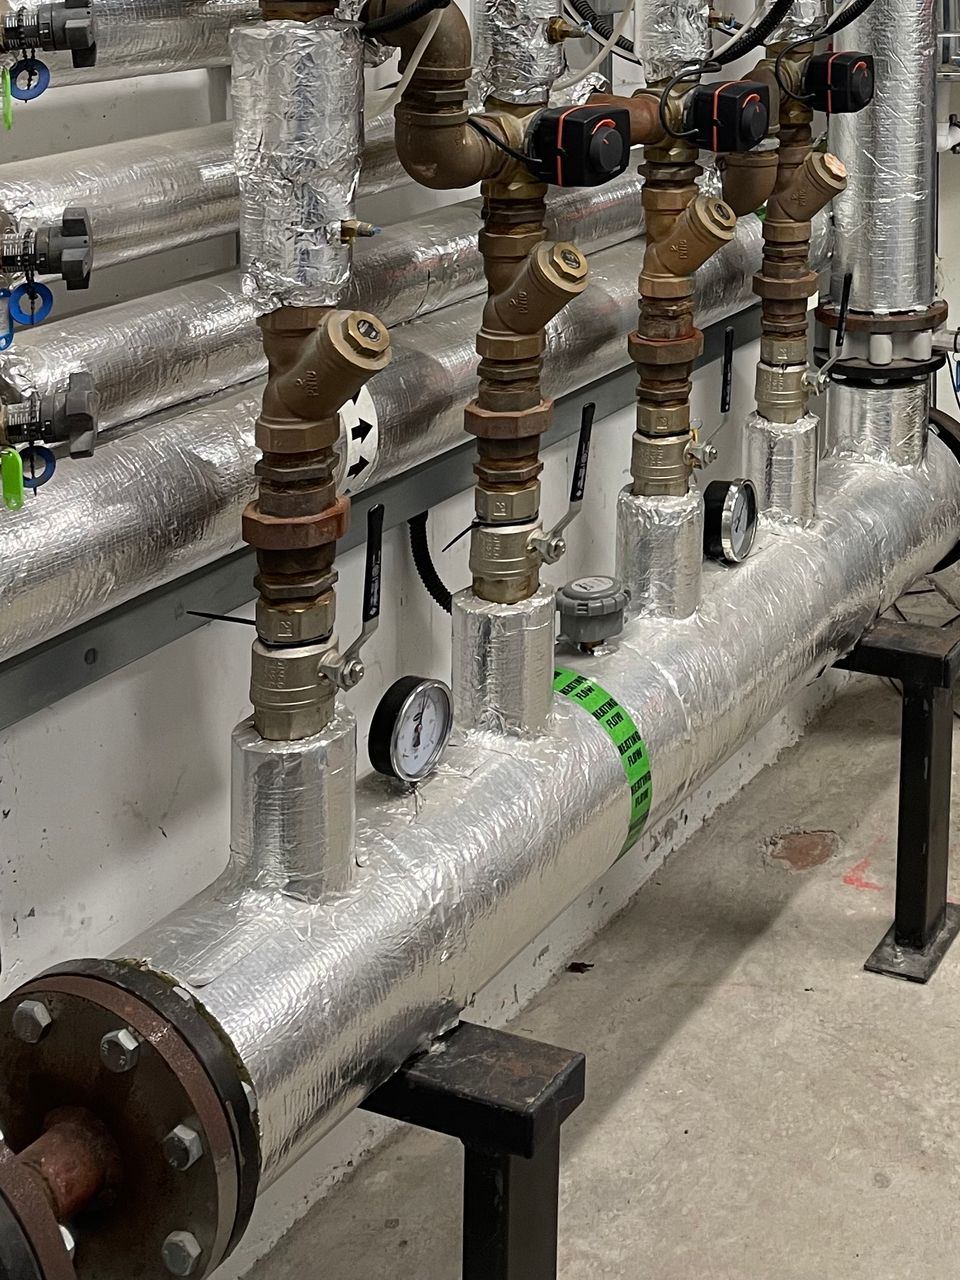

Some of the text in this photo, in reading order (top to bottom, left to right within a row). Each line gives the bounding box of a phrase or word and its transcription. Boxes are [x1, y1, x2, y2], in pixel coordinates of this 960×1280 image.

[558, 674, 588, 696] HEATING
[575, 685, 595, 701] FLOW
[591, 697, 619, 721] HEATING
[605, 711, 625, 730] FLOW
[618, 730, 642, 756] HEATING
[627, 747, 643, 767] FLOW
[630, 770, 651, 796] HEATING
[634, 787, 649, 809] FLOW
